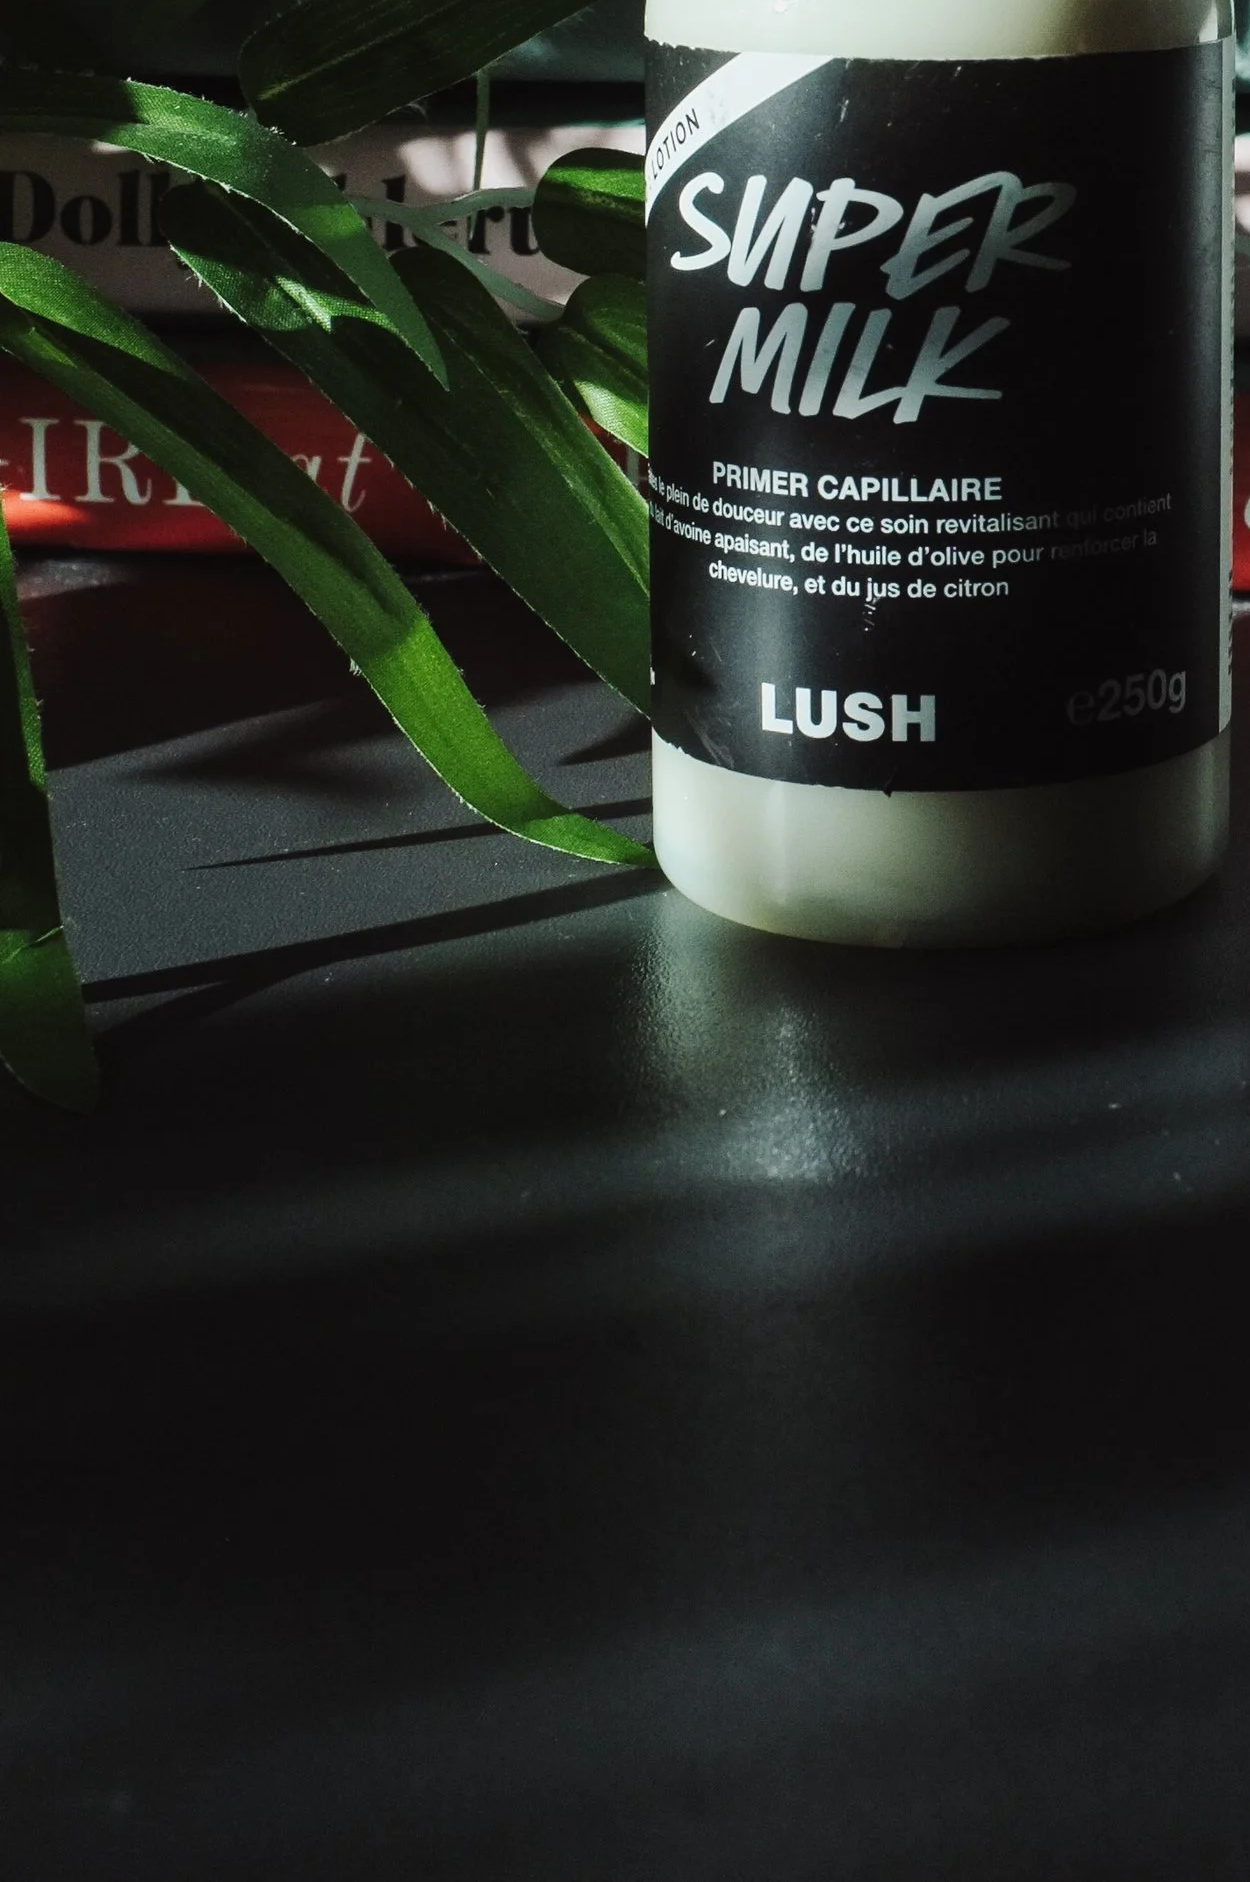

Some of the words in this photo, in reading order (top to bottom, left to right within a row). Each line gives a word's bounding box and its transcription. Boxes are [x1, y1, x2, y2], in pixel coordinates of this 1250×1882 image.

[651, 107, 700, 179] LOTION
[0, 169, 182, 256] Doll
[670, 170, 1078, 300] SUPER
[708, 301, 1012, 425] MILK
[666, 482, 690, 507] plein
[692, 491, 710, 513] de
[712, 496, 785, 527] douceur
[789, 511, 840, 532] avec
[845, 515, 875, 534] ce
[880, 513, 929, 535] soin
[935, 510, 1061, 535] revitalisant
[1065, 503, 1097, 530] qui
[1103, 492, 1172, 523] contient
[712, 460, 809, 498] PRIMER
[817, 474, 1003, 503] CAPILLAIRE
[665, 511, 712, 545] d'avoine
[714, 533, 796, 563] apaisant,
[800, 542, 829, 563] de
[834, 542, 902, 567] l'huile
[907, 545, 985, 567] d'olive
[992, 545, 1044, 569] pour
[1050, 534, 1139, 561] renforcer
[1143, 527, 1158, 548] la
[708, 559, 799, 595] chevelure,
[803, 575, 826, 595] et
[831, 575, 861, 597] du
[866, 576, 900, 602] jus
[906, 577, 937, 599] de
[943, 577, 1010, 599] citron
[760, 681, 936, 743] LUSH
